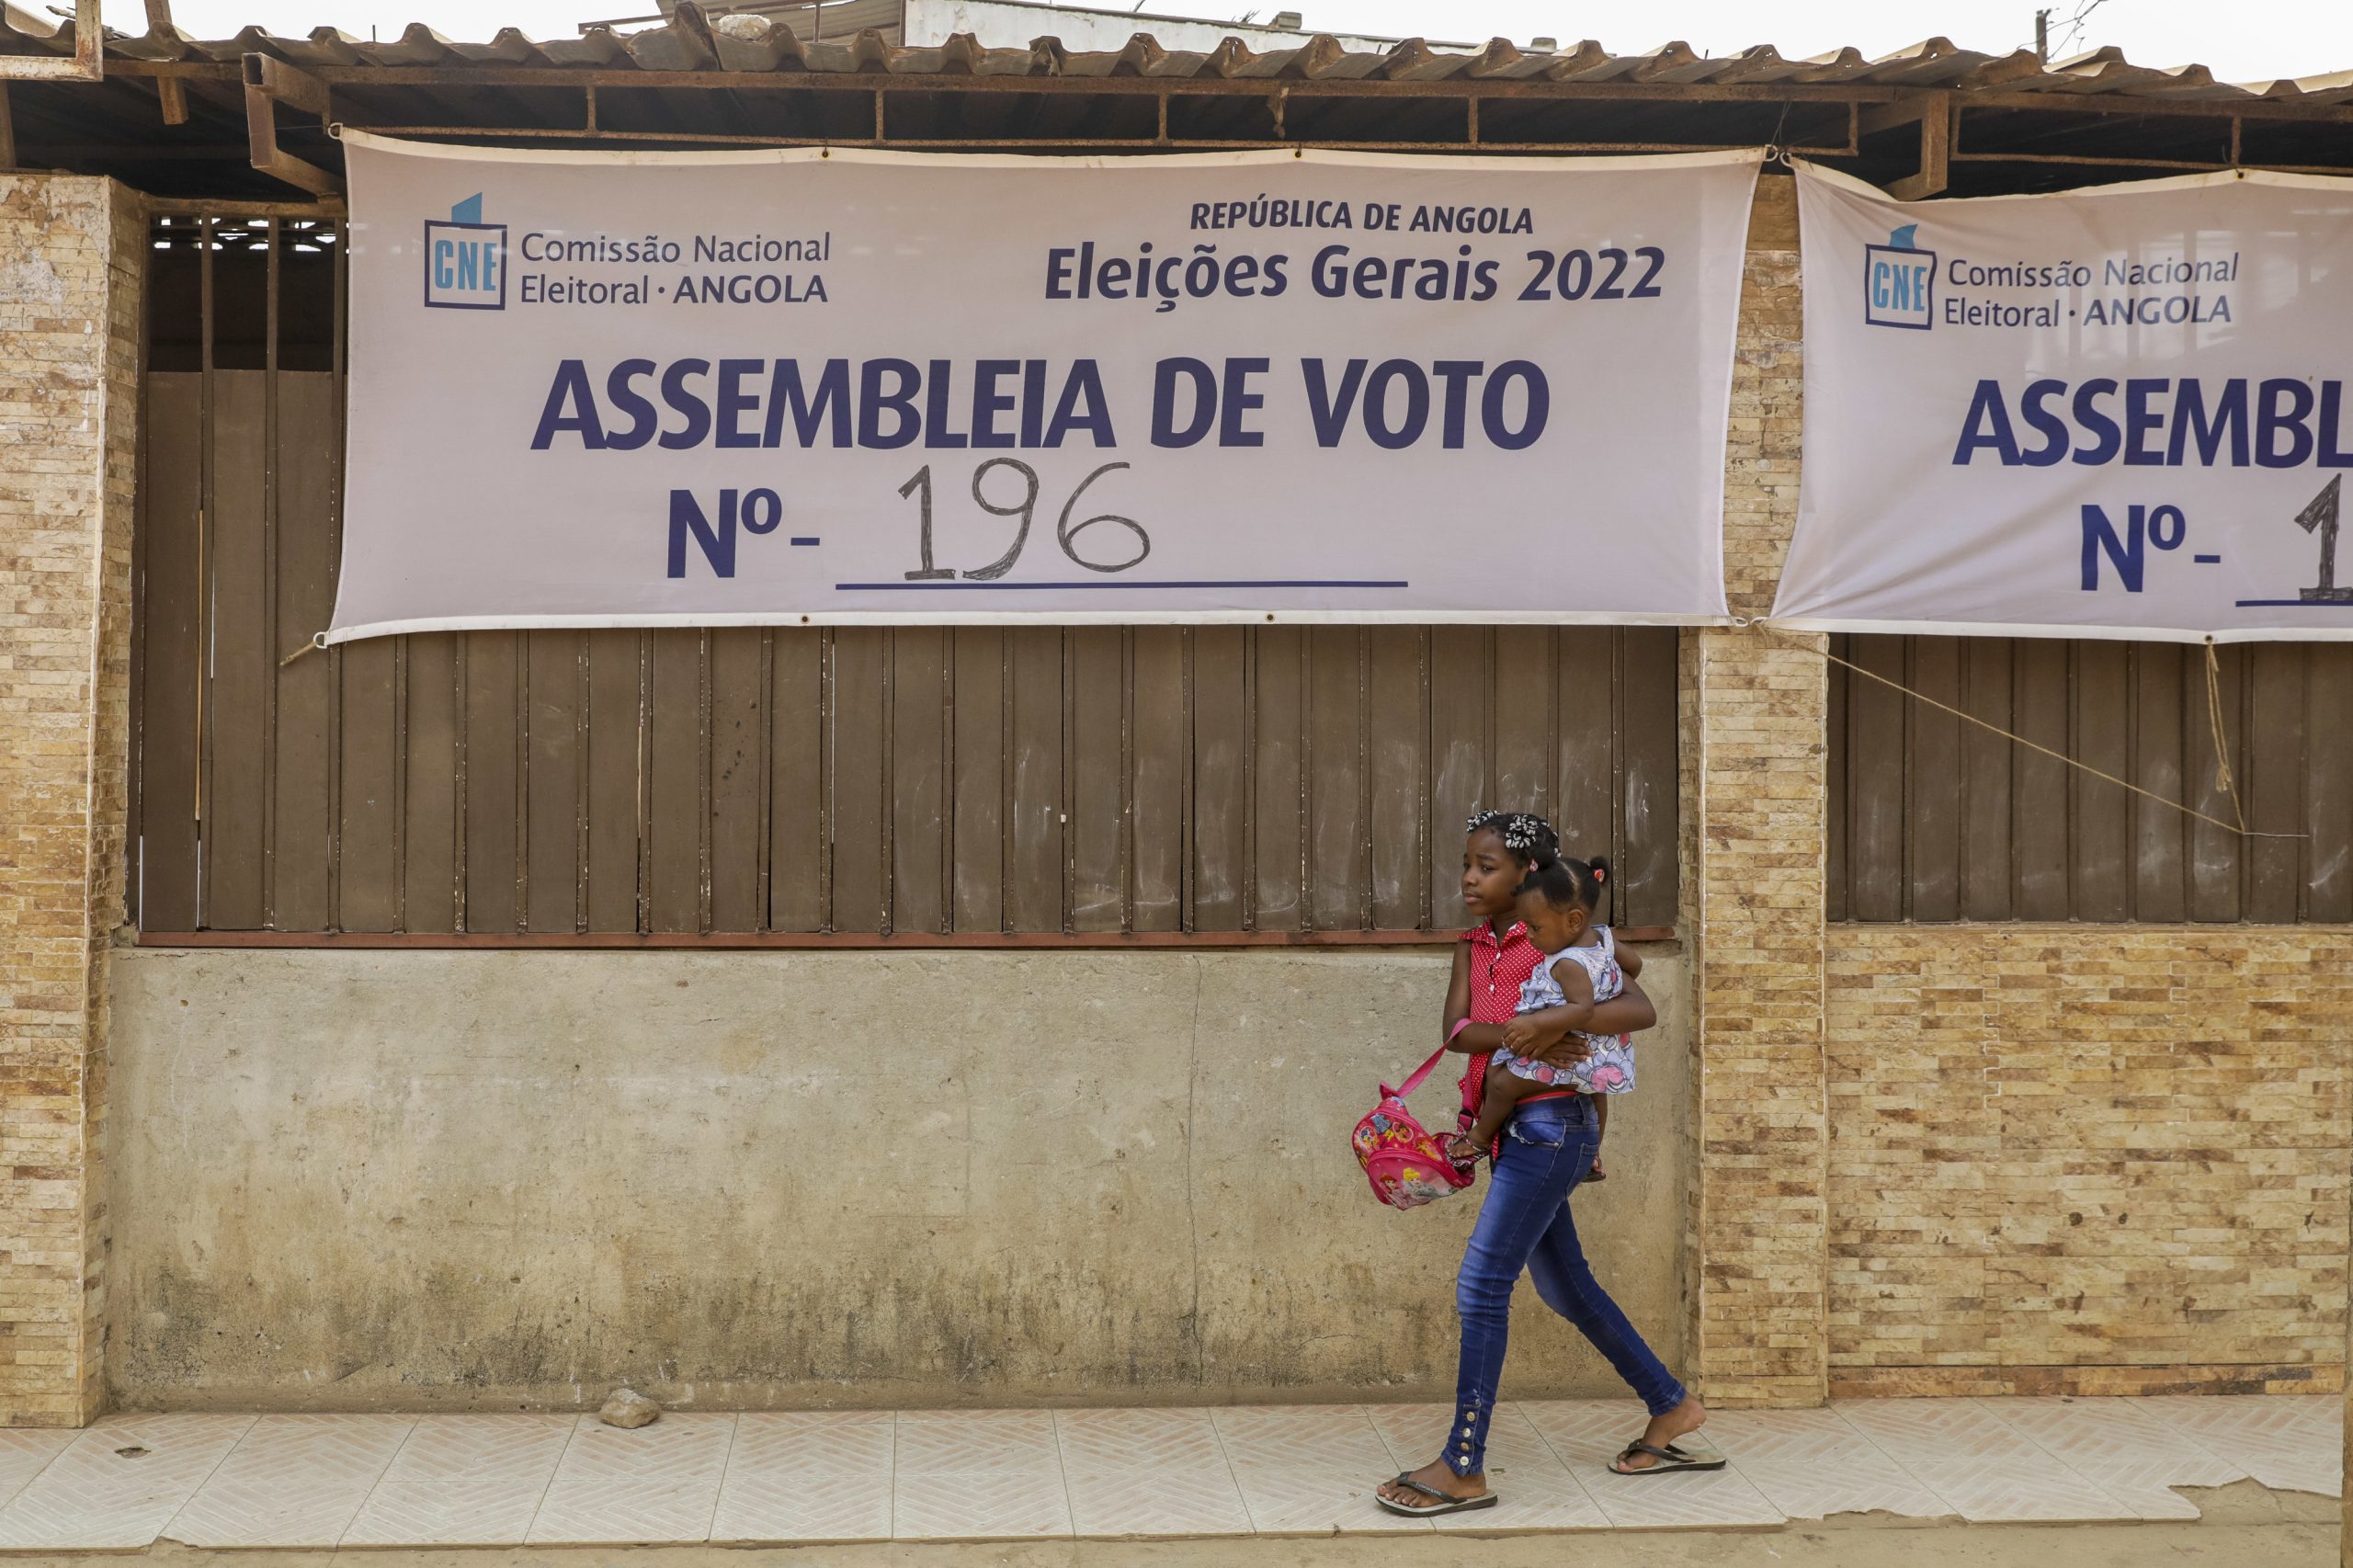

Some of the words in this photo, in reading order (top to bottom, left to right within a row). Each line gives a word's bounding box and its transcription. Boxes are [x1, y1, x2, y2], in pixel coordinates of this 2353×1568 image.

[1190, 192, 1353, 230] REPÚBLICA
[1363, 202, 1403, 232] DE
[1408, 205, 1534, 234] ANGOLA
[435, 240, 496, 291] CNE
[521, 233, 681, 263] Comissão
[694, 231, 830, 263] Nacional
[520, 275, 648, 304] Eleitoral
[673, 275, 828, 304] ANGOLA
[1045, 241, 1289, 313] Eleições
[1311, 244, 1500, 301] Gerais
[1518, 246, 1665, 301] 2022
[1872, 261, 1927, 312] CNE
[1948, 259, 2091, 289] Comissão
[2104, 252, 2239, 287] Nacional
[1944, 298, 2060, 328] Eleitoral
[2083, 294, 2233, 326] ANGOLA
[529, 358, 1118, 451] ASSEMBLEIA
[1150, 357, 1270, 449] DE
[1300, 358, 1551, 451] VOTO
[897, 456, 1152, 582] 196
